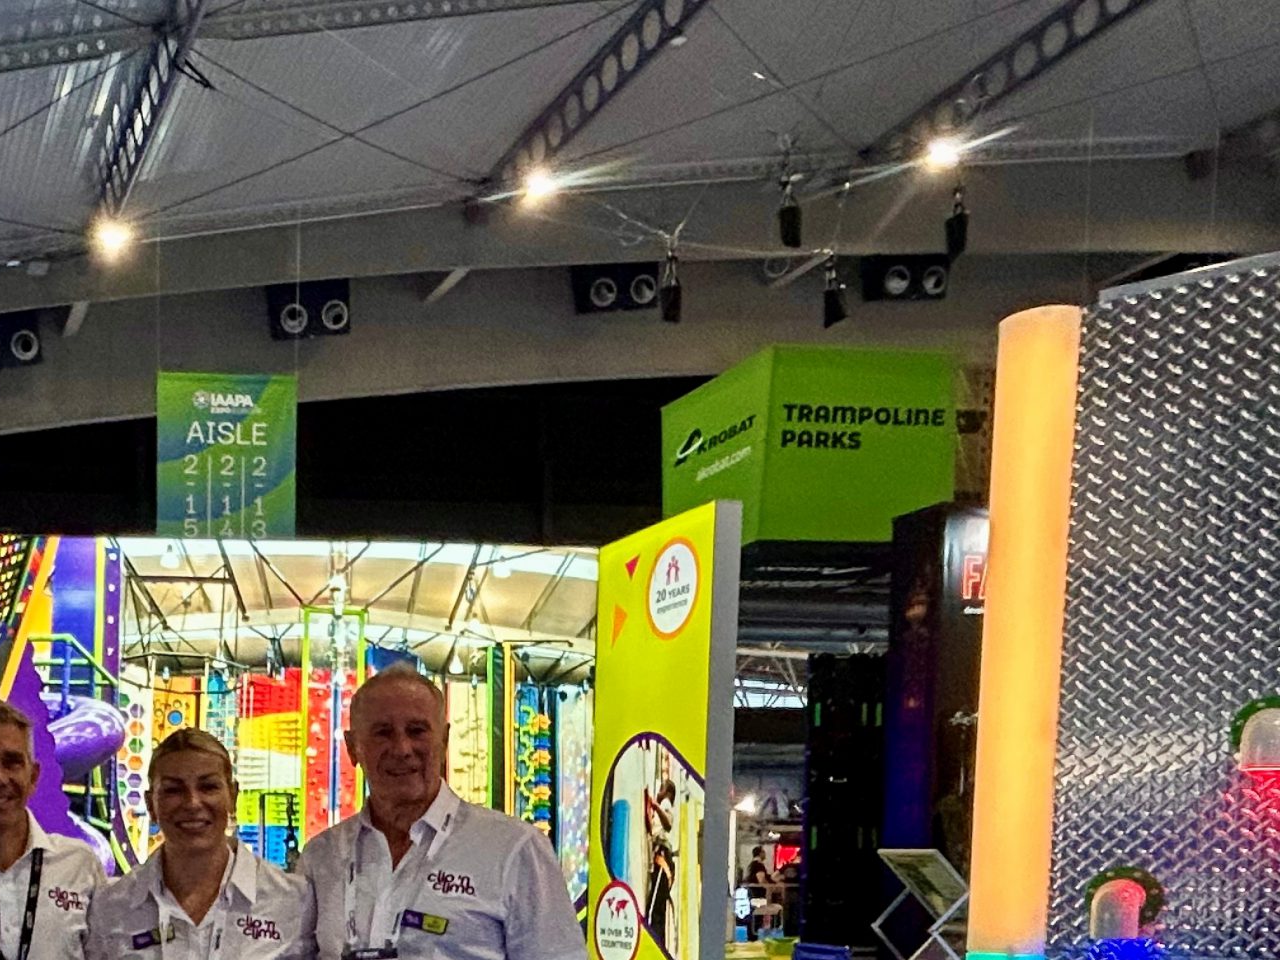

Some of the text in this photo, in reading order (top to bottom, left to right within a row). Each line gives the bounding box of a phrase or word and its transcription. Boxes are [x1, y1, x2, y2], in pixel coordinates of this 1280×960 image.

[211, 393, 254, 407] IAAPA
[782, 404, 946, 427] TRAMPOLINE
[186, 421, 268, 446] AISLE
[780, 429, 862, 450] PARKS
[656, 584, 690, 604] 20 YEARS
[624, 926, 634, 938] 50
